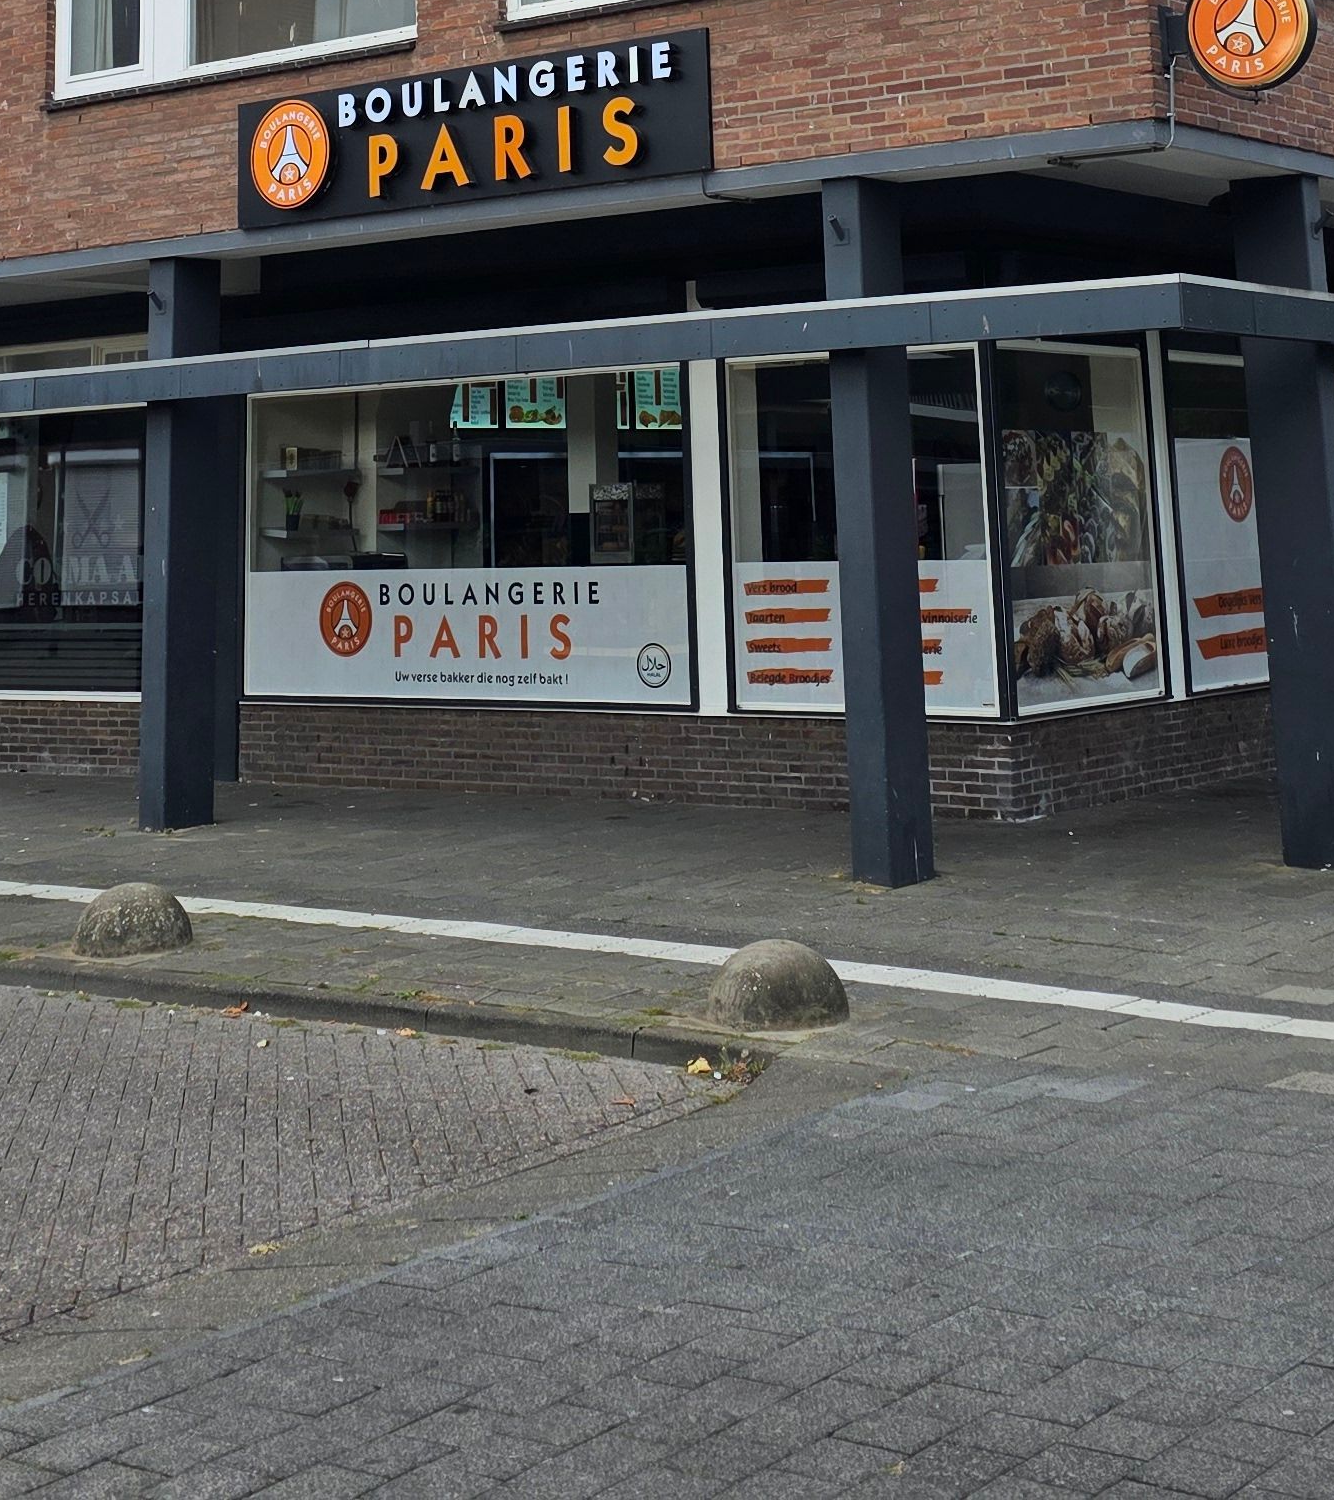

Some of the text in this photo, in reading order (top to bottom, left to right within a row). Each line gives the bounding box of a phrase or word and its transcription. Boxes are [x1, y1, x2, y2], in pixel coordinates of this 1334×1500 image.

[1205, 44, 1265, 75] PARIS
[338, 40, 673, 128] BOULANGERIE
[259, 110, 322, 149] BOULANGERIE
[368, 96, 641, 199] PARIS
[268, 179, 312, 201] PARIS
[379, 581, 601, 606] BOULANGERIE
[769, 582, 797, 594] brood
[747, 612, 786, 624] Taarten
[330, 636, 361, 652] PARIS
[394, 613, 573, 661] PARIS
[641, 654, 667, 672] حلال
[395, 671, 410, 682] Uw
[411, 672, 438, 683] verse
[440, 671, 475, 684] bakker
[477, 672, 494, 684] die
[495, 674, 516, 687] nog
[517, 672, 537, 685] zelf
[539, 673, 564, 685] bakt
